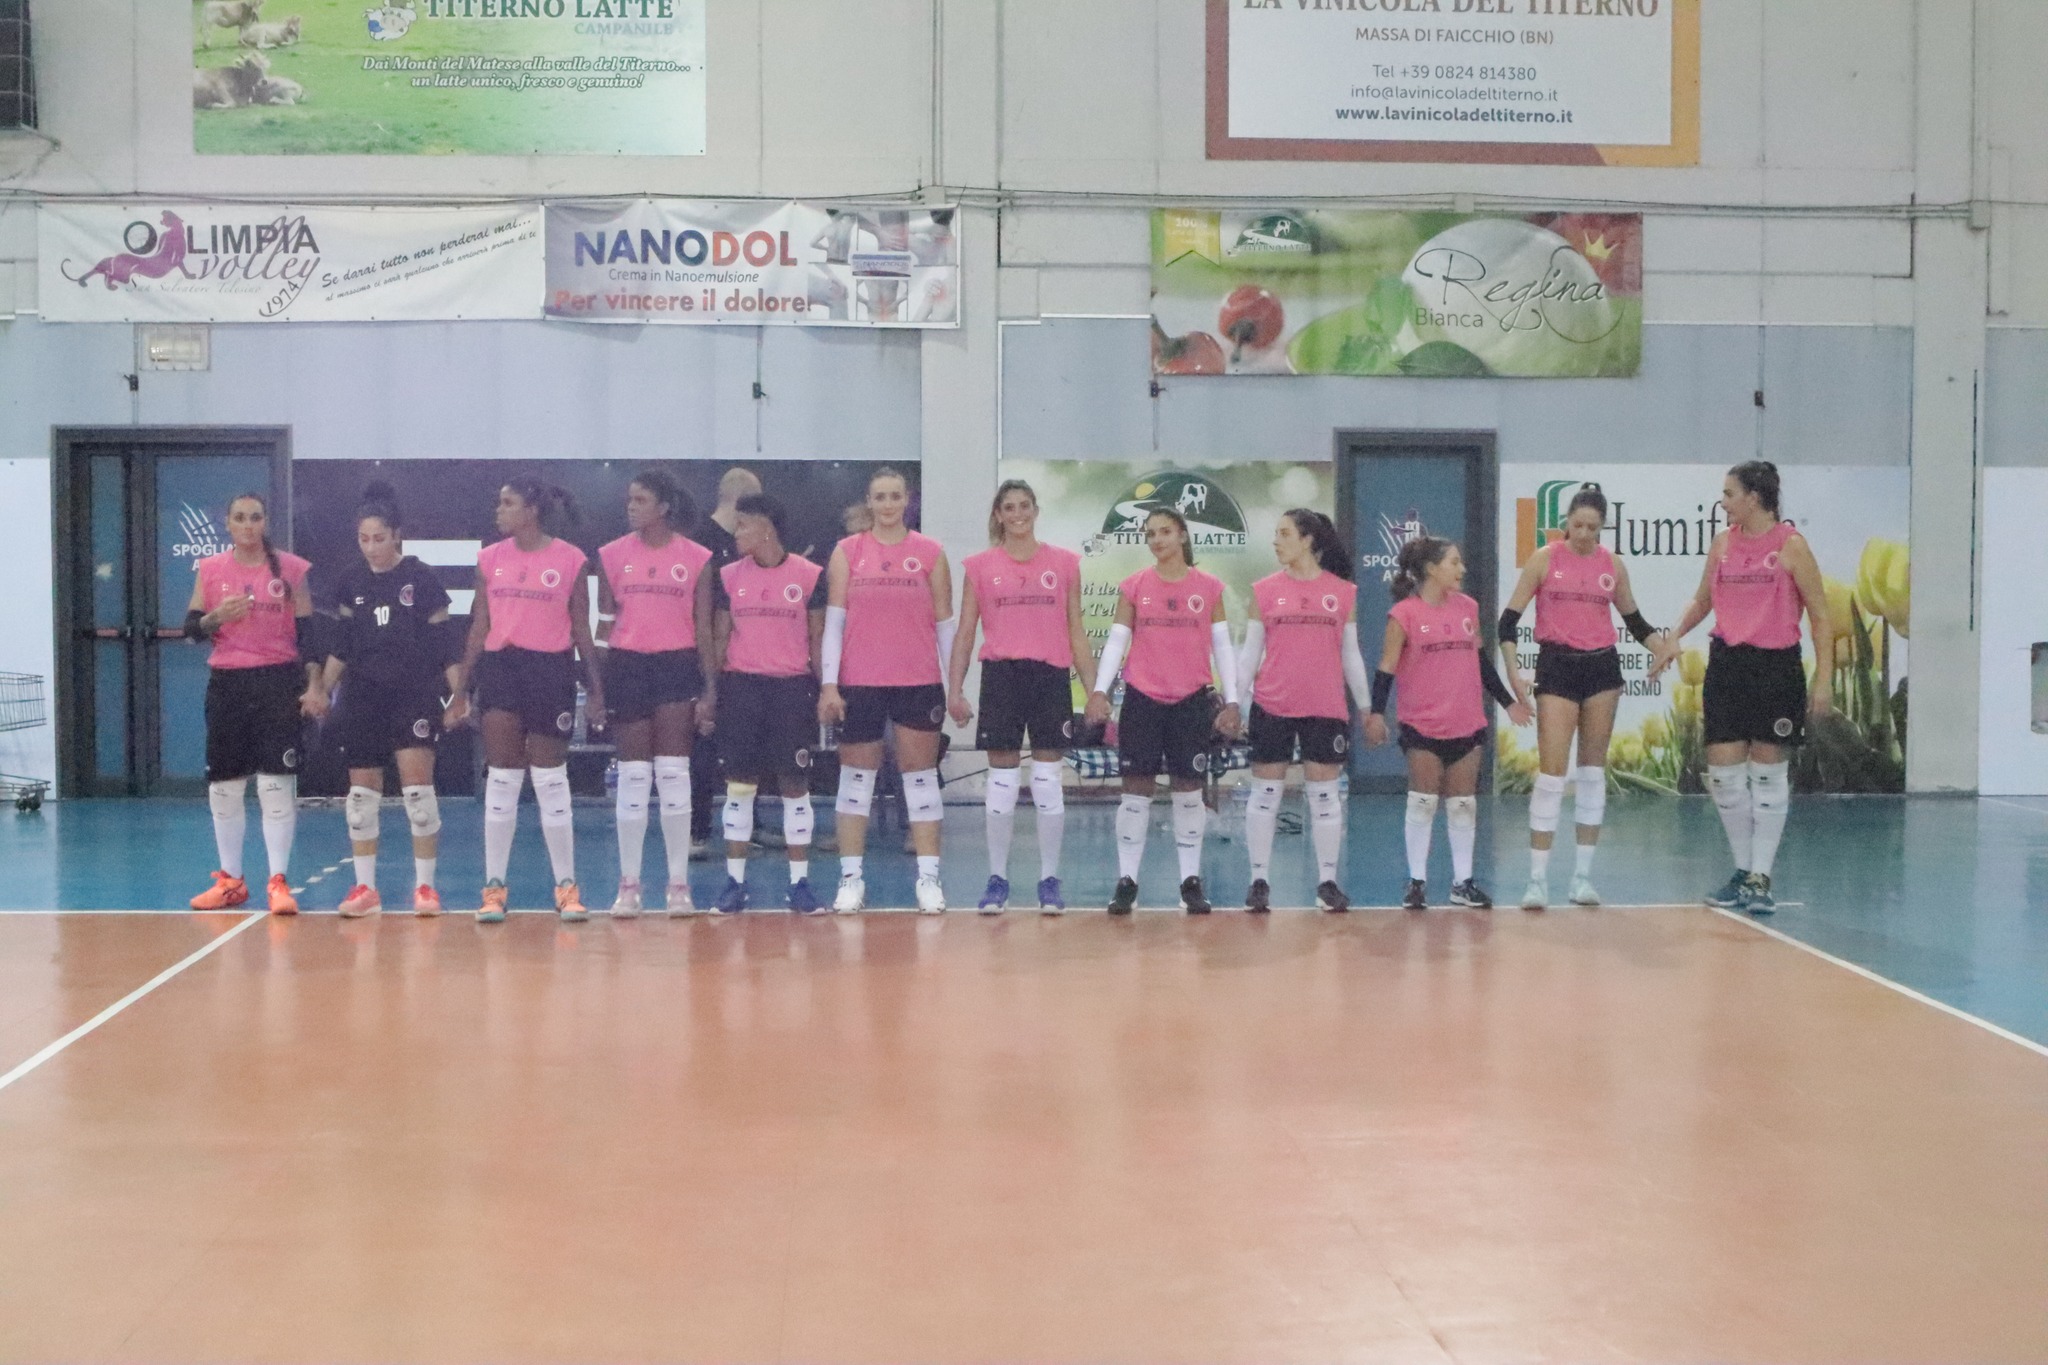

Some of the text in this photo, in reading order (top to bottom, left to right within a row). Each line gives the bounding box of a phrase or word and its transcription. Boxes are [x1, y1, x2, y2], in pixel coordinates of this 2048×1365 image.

[424, 0, 674, 18] TITERNO LATTE
[574, 22, 673, 35] CAMPANILE
[1355, 27, 1554, 45] MASSA DI FAICCHIO (BN)
[362, 56, 691, 72] Dai Monti del Matese alla valle del Titerno...
[1372, 63, 1537, 81] Tel +39 0824 814380
[410, 74, 644, 92] un latte unico, fresco e genuino!
[1350, 84, 1558, 102] info@lavinicoladeltiterno.it
[1335, 106, 1574, 125] www.lavinicoladeltiterno.it
[196, 216, 321, 290] volley
[575, 229, 798, 267] NANODOL
[321, 273, 339, 288] Se
[343, 263, 377, 281] darai
[380, 254, 409, 270] tutto
[413, 246, 435, 260] non
[440, 228, 489, 255] perderai
[608, 268, 760, 283] Crema in Nanoemulsione
[265, 280, 300, 314] 1974
[1414, 245, 1613, 334] Regina
[555, 291, 594, 312] Per
[604, 290, 695, 312] vincere
[702, 289, 716, 312] il
[1415, 307, 1484, 328] Bianca
[1193, 533, 1246, 545] LATTE
[373, 606, 390, 626] 10
